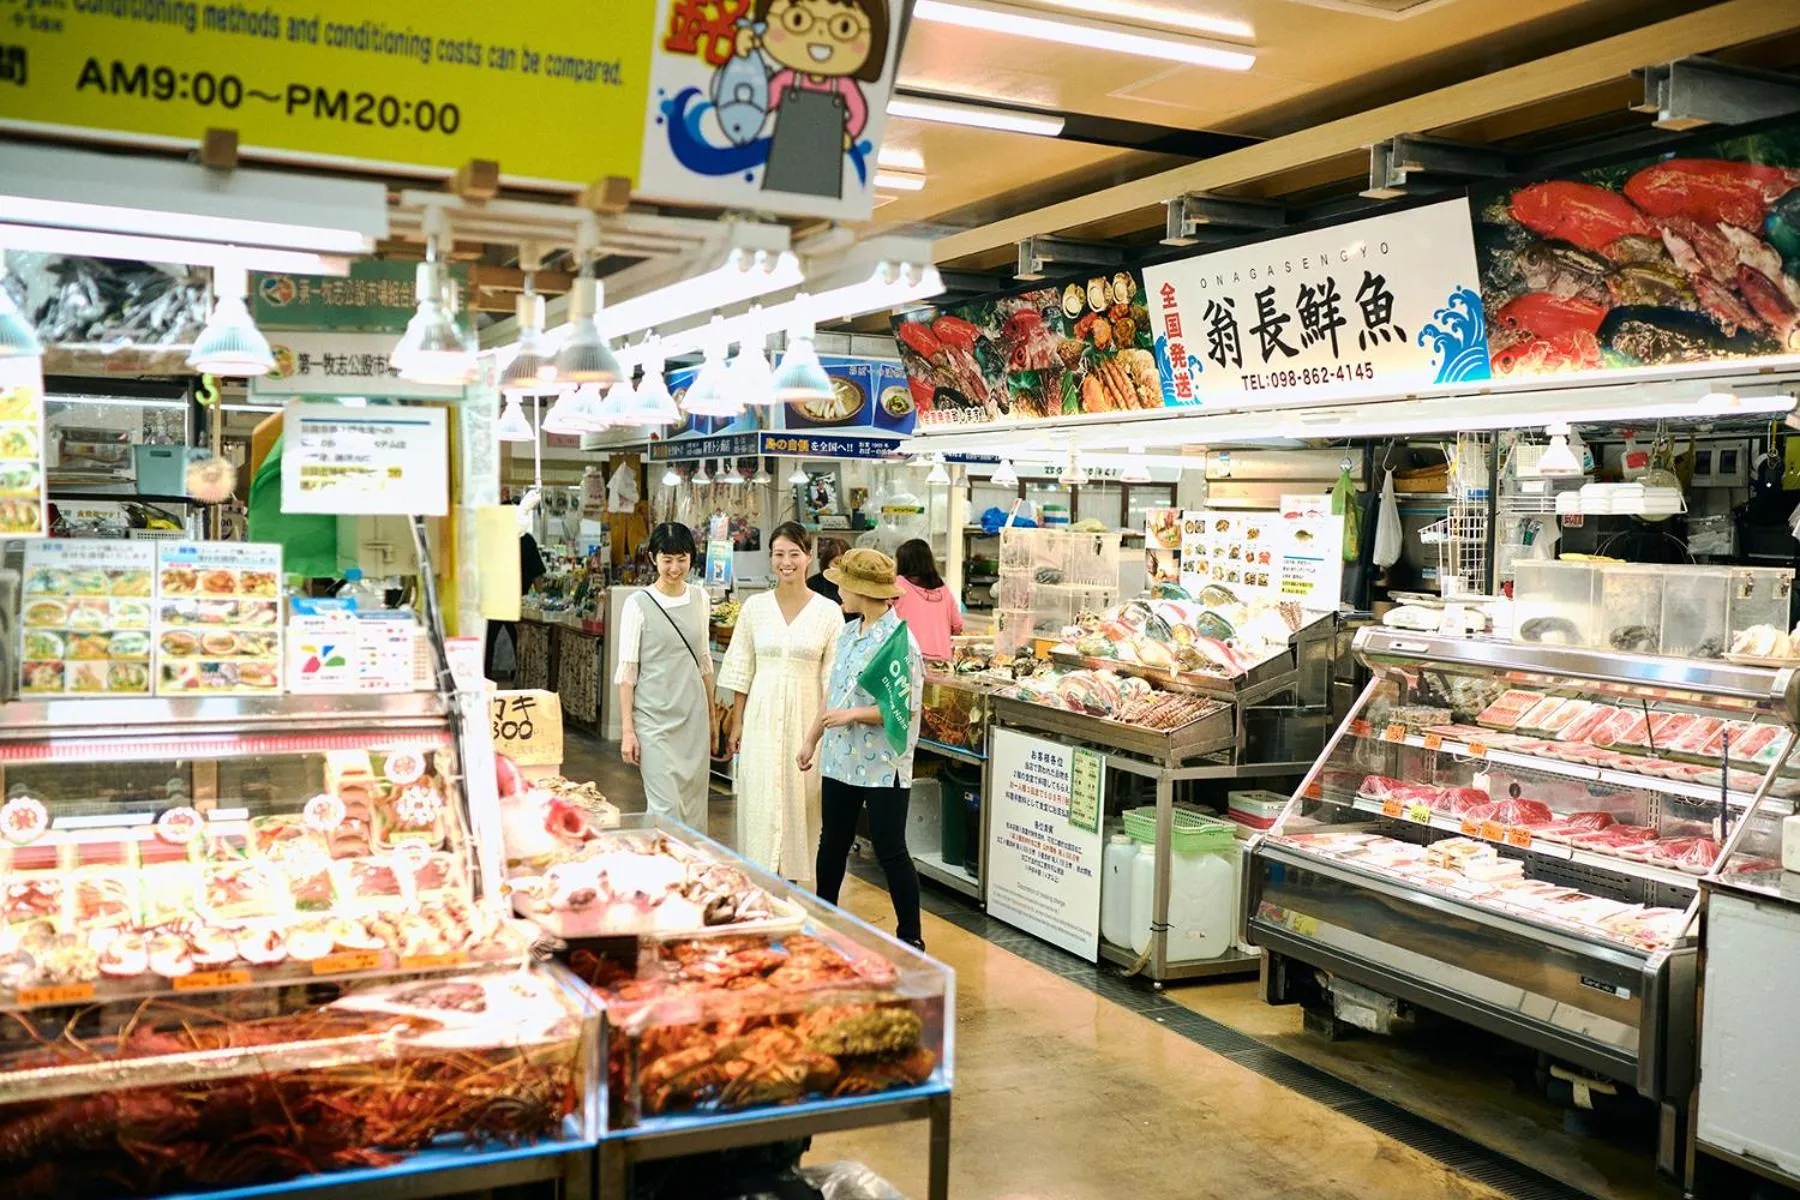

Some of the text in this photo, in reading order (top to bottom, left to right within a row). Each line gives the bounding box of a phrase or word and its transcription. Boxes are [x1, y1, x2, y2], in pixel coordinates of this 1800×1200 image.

[202, 3, 281, 38] methods
[286, 15, 320, 44] and
[323, 19, 432, 64] conditioning
[435, 36, 482, 67] costs
[487, 44, 516, 71] can
[520, 41, 540, 74] be
[544, 52, 623, 86] compared.
[1159, 281, 1192, 399] 全国発送
[1202, 269, 1408, 369] 翁長鮮魚
[1241, 361, 1374, 392] TEL:098-862-4145
